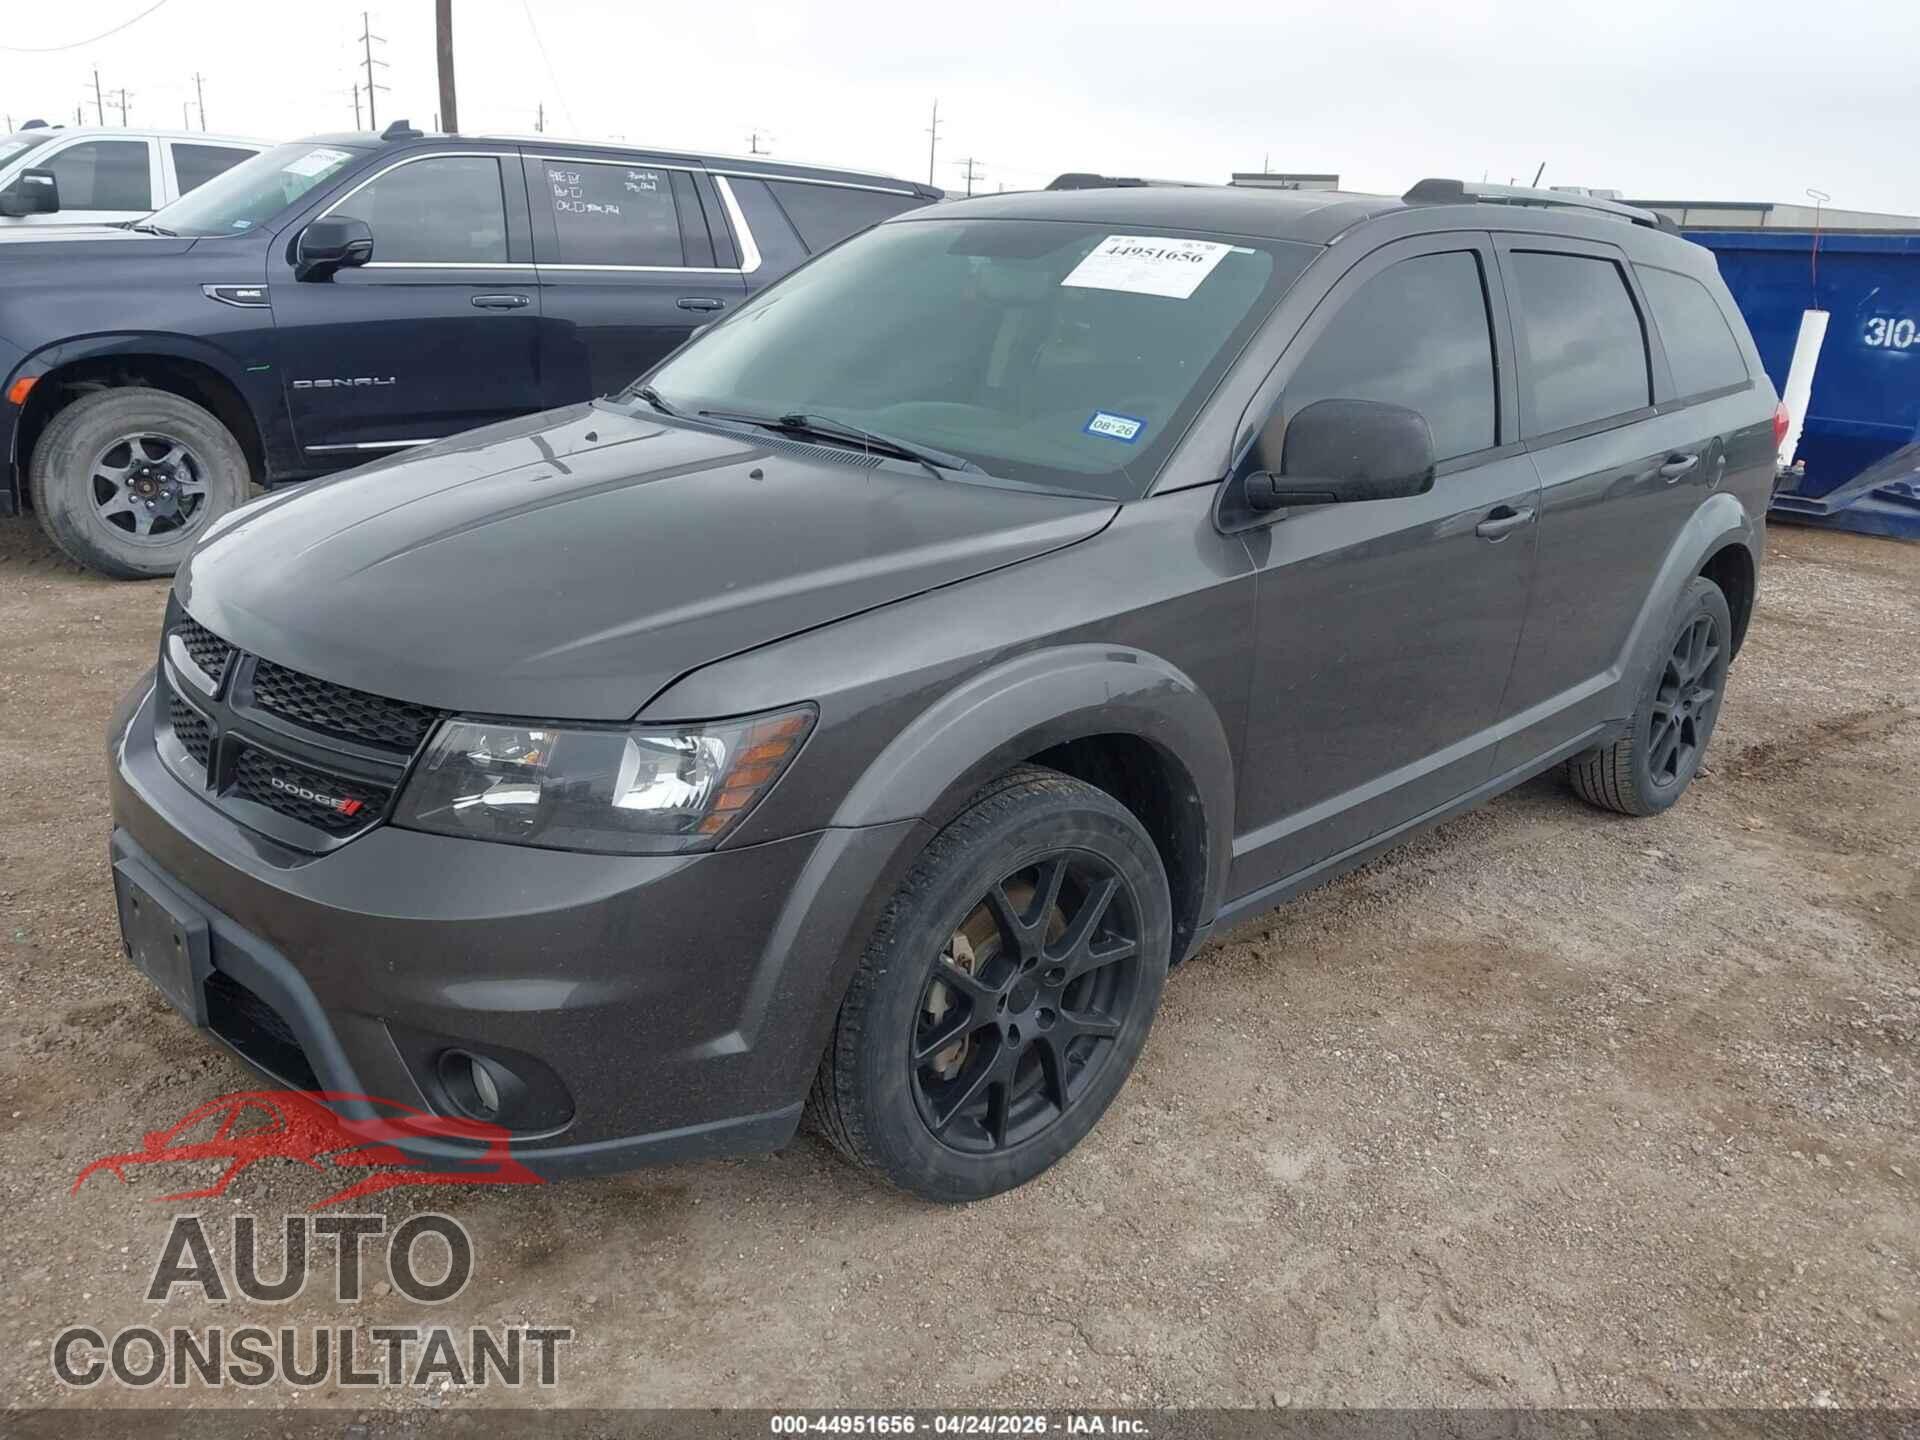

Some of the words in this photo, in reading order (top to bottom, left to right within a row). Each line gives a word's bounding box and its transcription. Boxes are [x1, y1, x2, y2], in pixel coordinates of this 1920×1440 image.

[1105, 246, 1204, 264] 44951656
[1864, 317, 1920, 349] 310
[293, 376, 396, 388] DENALI
[271, 777, 346, 809] DODGE
